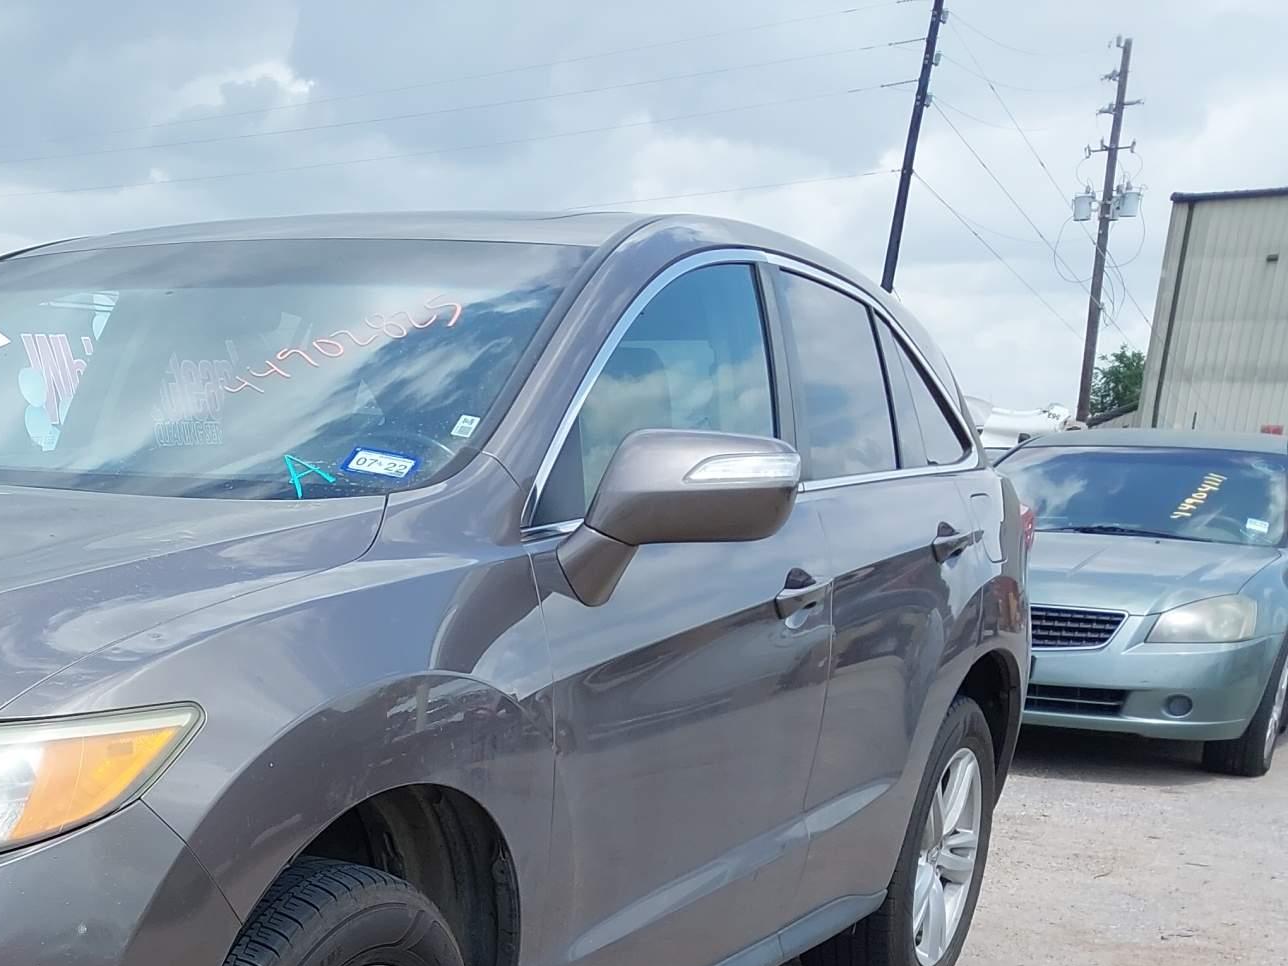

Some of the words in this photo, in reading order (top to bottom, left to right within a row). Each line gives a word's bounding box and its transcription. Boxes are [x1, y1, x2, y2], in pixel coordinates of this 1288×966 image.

[223, 295, 462, 393] 44902825
[283, 454, 337, 499] A
[1169, 472, 1229, 520] 44904111
